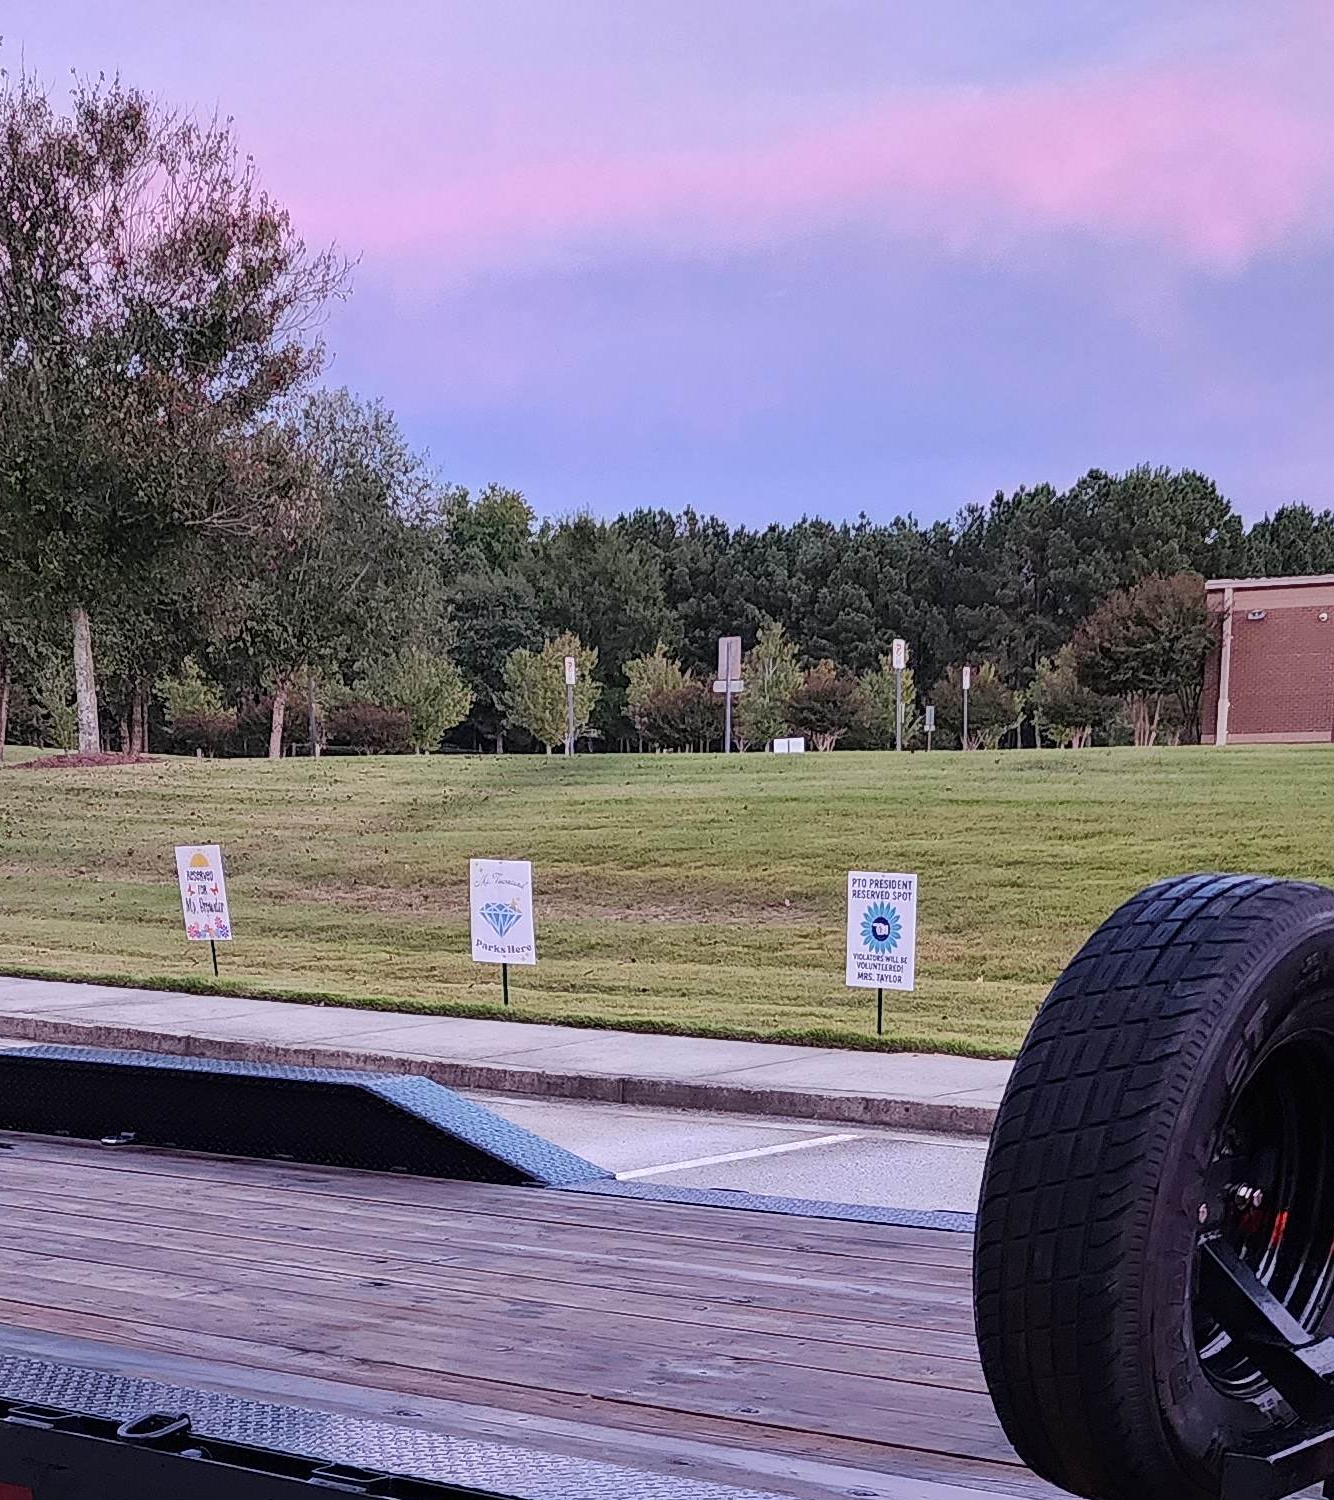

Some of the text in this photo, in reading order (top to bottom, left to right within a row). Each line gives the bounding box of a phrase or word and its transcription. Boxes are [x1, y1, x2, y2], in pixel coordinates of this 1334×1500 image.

[852, 878, 913, 891] PTO PRESIDENT
[851, 890, 912, 902] RESERVED SPOT
[853, 953, 908, 965] VIOLATORS WILL BE
[857, 972, 903, 983] MRS. TAYLOR
